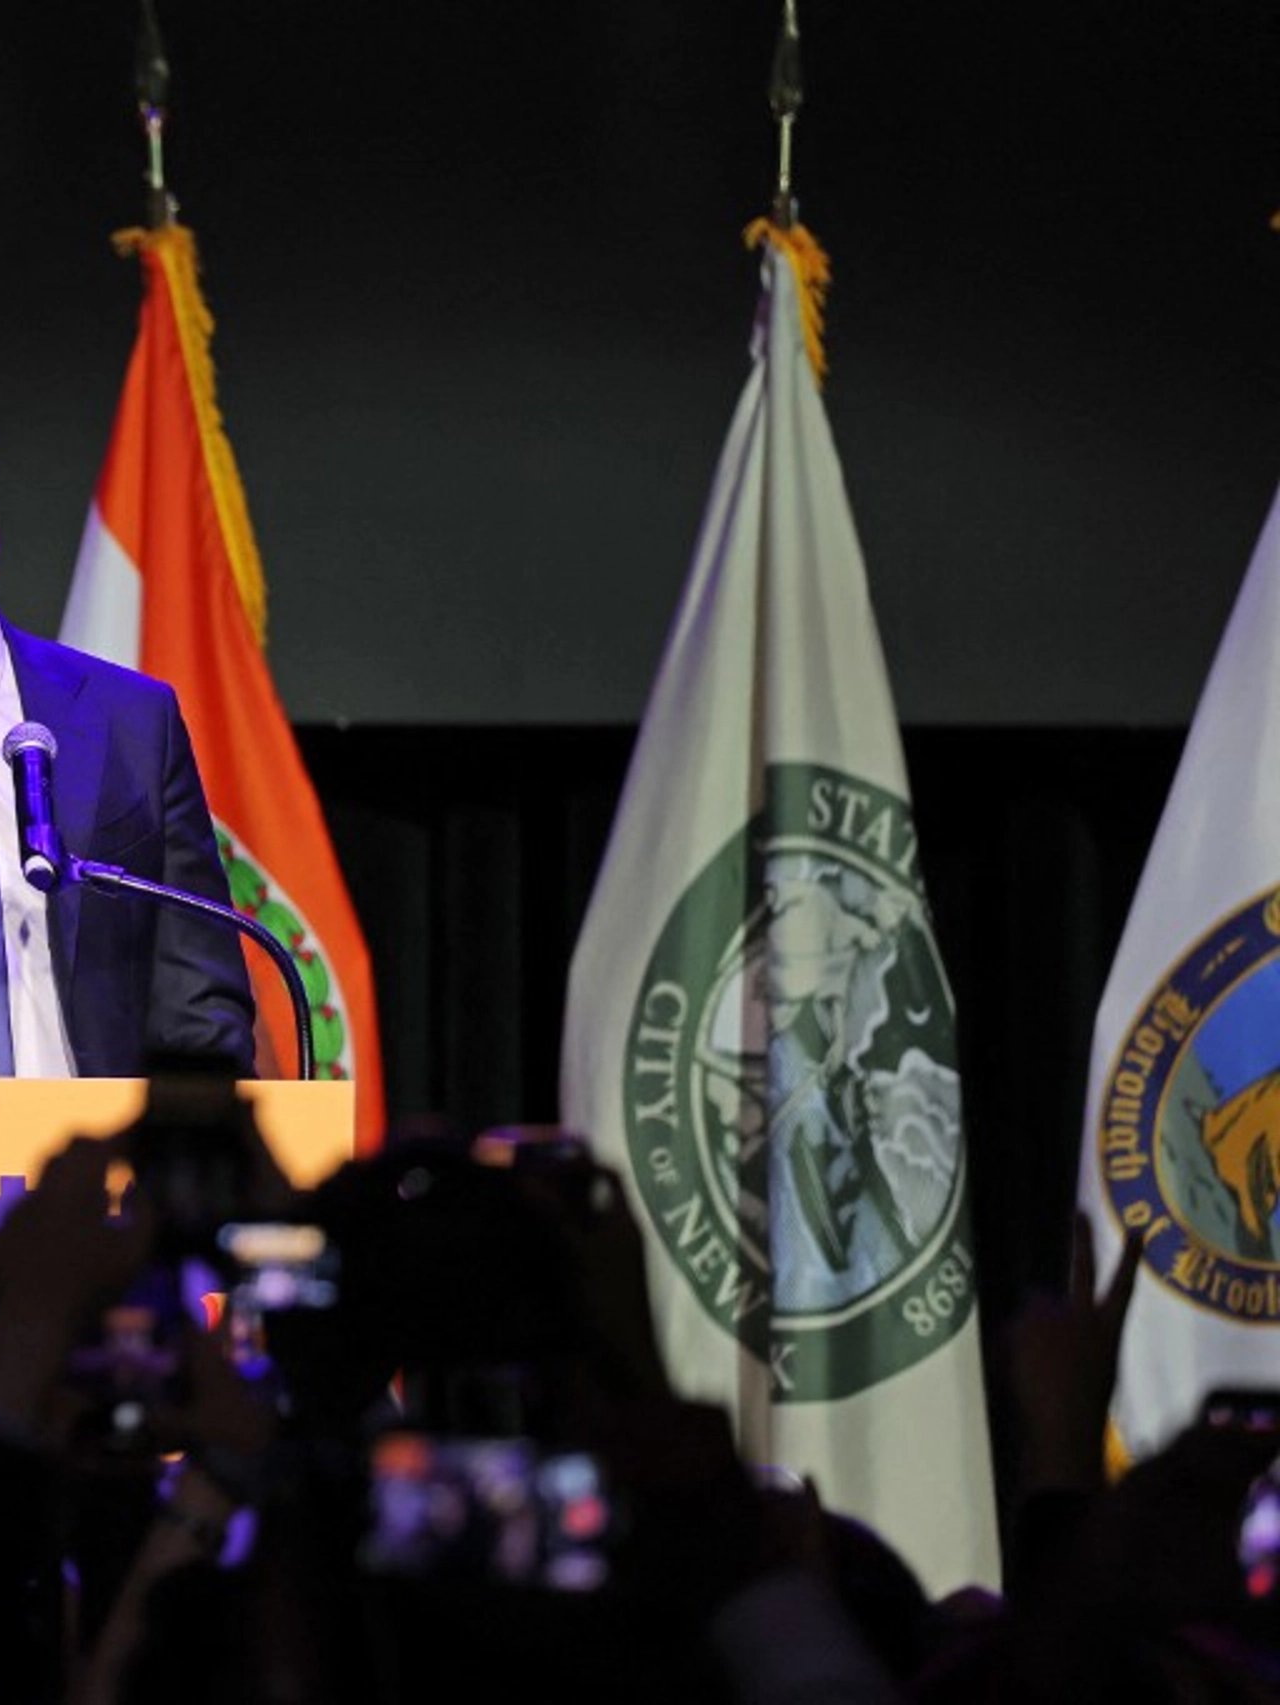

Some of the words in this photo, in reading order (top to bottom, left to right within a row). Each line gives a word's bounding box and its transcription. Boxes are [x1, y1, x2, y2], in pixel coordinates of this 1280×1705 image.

[634, 980, 688, 1135] CITY
[1107, 988, 1201, 1181] Borough
[650, 1148, 677, 1186] OF
[664, 1194, 767, 1323] NEW
[904, 1242, 973, 1338] 1898
